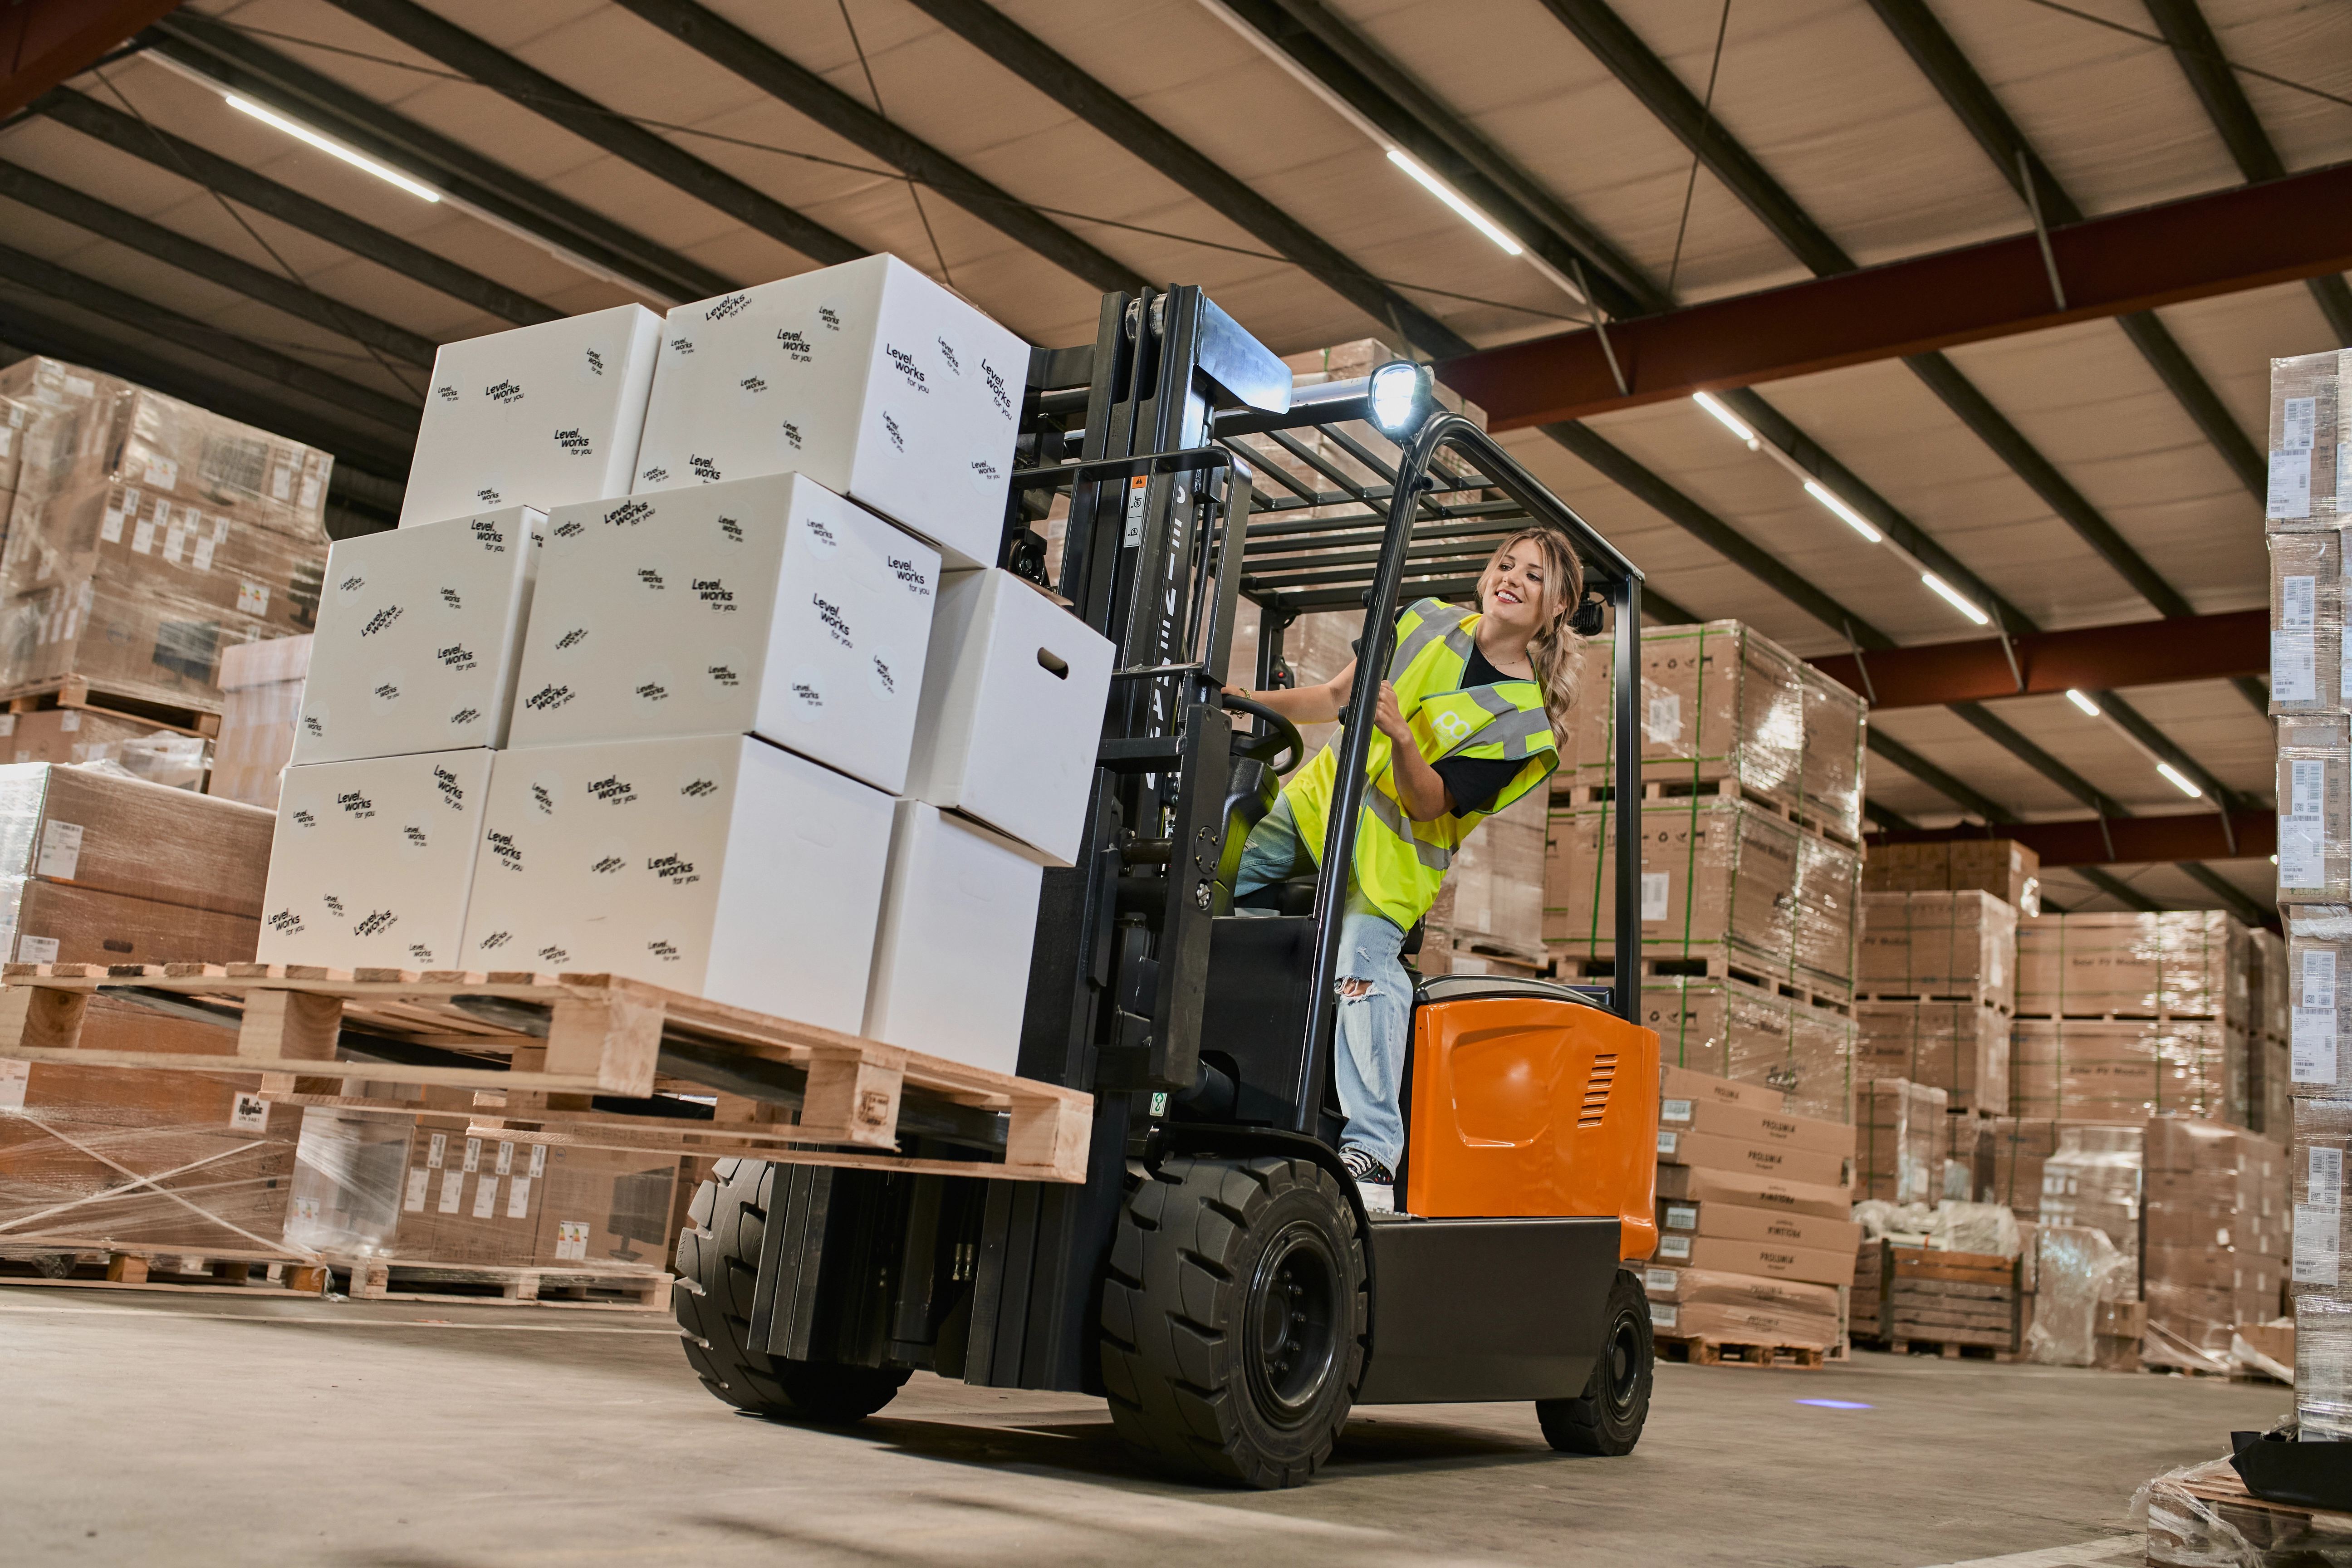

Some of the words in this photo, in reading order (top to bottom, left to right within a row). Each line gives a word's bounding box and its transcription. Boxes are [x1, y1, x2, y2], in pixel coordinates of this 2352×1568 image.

[706, 296, 733, 320] Level.
[716, 294, 745, 320] works
[740, 299, 751, 310] you
[777, 329, 802, 341] Level.
[783, 341, 810, 352] works
[887, 344, 914, 366] Level.
[896, 361, 924, 381] works
[982, 358, 1004, 391] Level.
[486, 379, 510, 396] Level.
[907, 377, 916, 387] for
[918, 384, 929, 393] you
[987, 377, 1011, 407] works
[494, 386, 519, 400] works
[514, 393, 524, 402] you
[994, 397, 1002, 407] for
[1002, 407, 1012, 420] you
[554, 428, 580, 439] Level.
[562, 436, 589, 447] works
[690, 455, 713, 468] Level.
[695, 467, 720, 480] works
[604, 500, 635, 524] Level.
[615, 502, 648, 525] works
[631, 517, 640, 526] for
[642, 509, 655, 520] you
[471, 519, 495, 531] Level.
[477, 531, 503, 542] works
[888, 556, 914, 572] Level.
[692, 579, 722, 590] Level.
[897, 571, 924, 584] works
[701, 589, 733, 601] works
[909, 583, 917, 592] for
[813, 593, 839, 619] Level.
[371, 605, 396, 634] works
[393, 608, 403, 620] you
[361, 609, 385, 637] Level.
[821, 612, 849, 635] works
[832, 630, 840, 639] for
[842, 638, 853, 648] you
[438, 643, 463, 658] Level.
[446, 652, 472, 665] works
[466, 662, 476, 671] you
[526, 684, 556, 708] Level.
[537, 686, 568, 710] works
[552, 701, 561, 709] for
[563, 692, 575, 704] you
[434, 765, 456, 785] Level.
[438, 780, 463, 799] works
[588, 775, 619, 793] Level.
[598, 783, 631, 799] works
[338, 790, 362, 804] Level.
[624, 795, 637, 804] you
[346, 799, 371, 811] works
[452, 802, 462, 810] you
[487, 829, 513, 846] Level.
[494, 845, 521, 860] works
[503, 858, 511, 867] for
[648, 853, 680, 869] Level.
[659, 862, 693, 877] works
[686, 876, 699, 884] you
[269, 908, 290, 925] Level.
[276, 916, 299, 931] works
[354, 910, 379, 936] Level.
[364, 910, 391, 936] works
[387, 916, 397, 928] you
[295, 926, 304, 934] you
[1762, 1119, 1796, 1133] PROLUMIA
[1748, 1150, 1783, 1164] PROLUMIA
[1760, 1252, 1794, 1264] PROLUMIA
